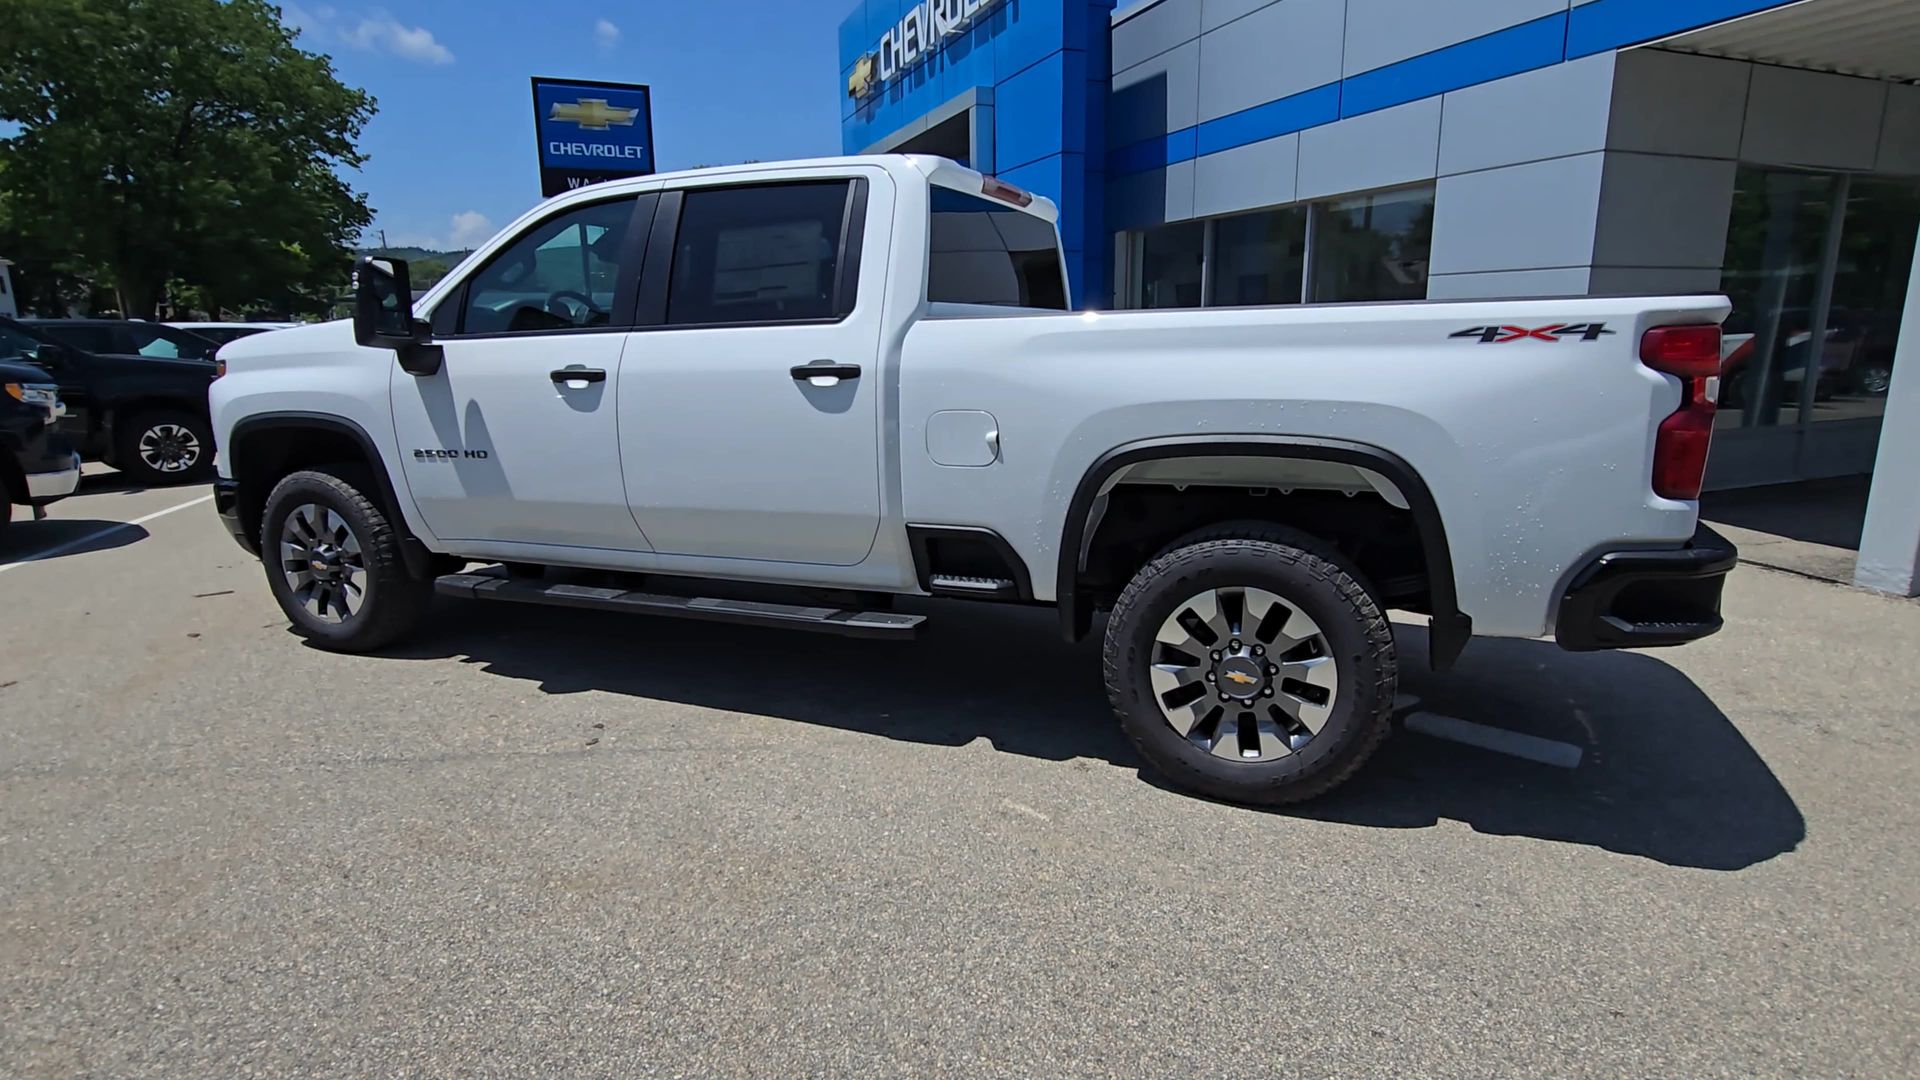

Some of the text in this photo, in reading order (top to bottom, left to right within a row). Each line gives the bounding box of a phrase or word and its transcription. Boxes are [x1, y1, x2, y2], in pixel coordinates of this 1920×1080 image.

[880, 0, 989, 81] CHEVRO
[550, 141, 643, 159] CHEVROLET
[413, 448, 488, 459] 2500 HD
